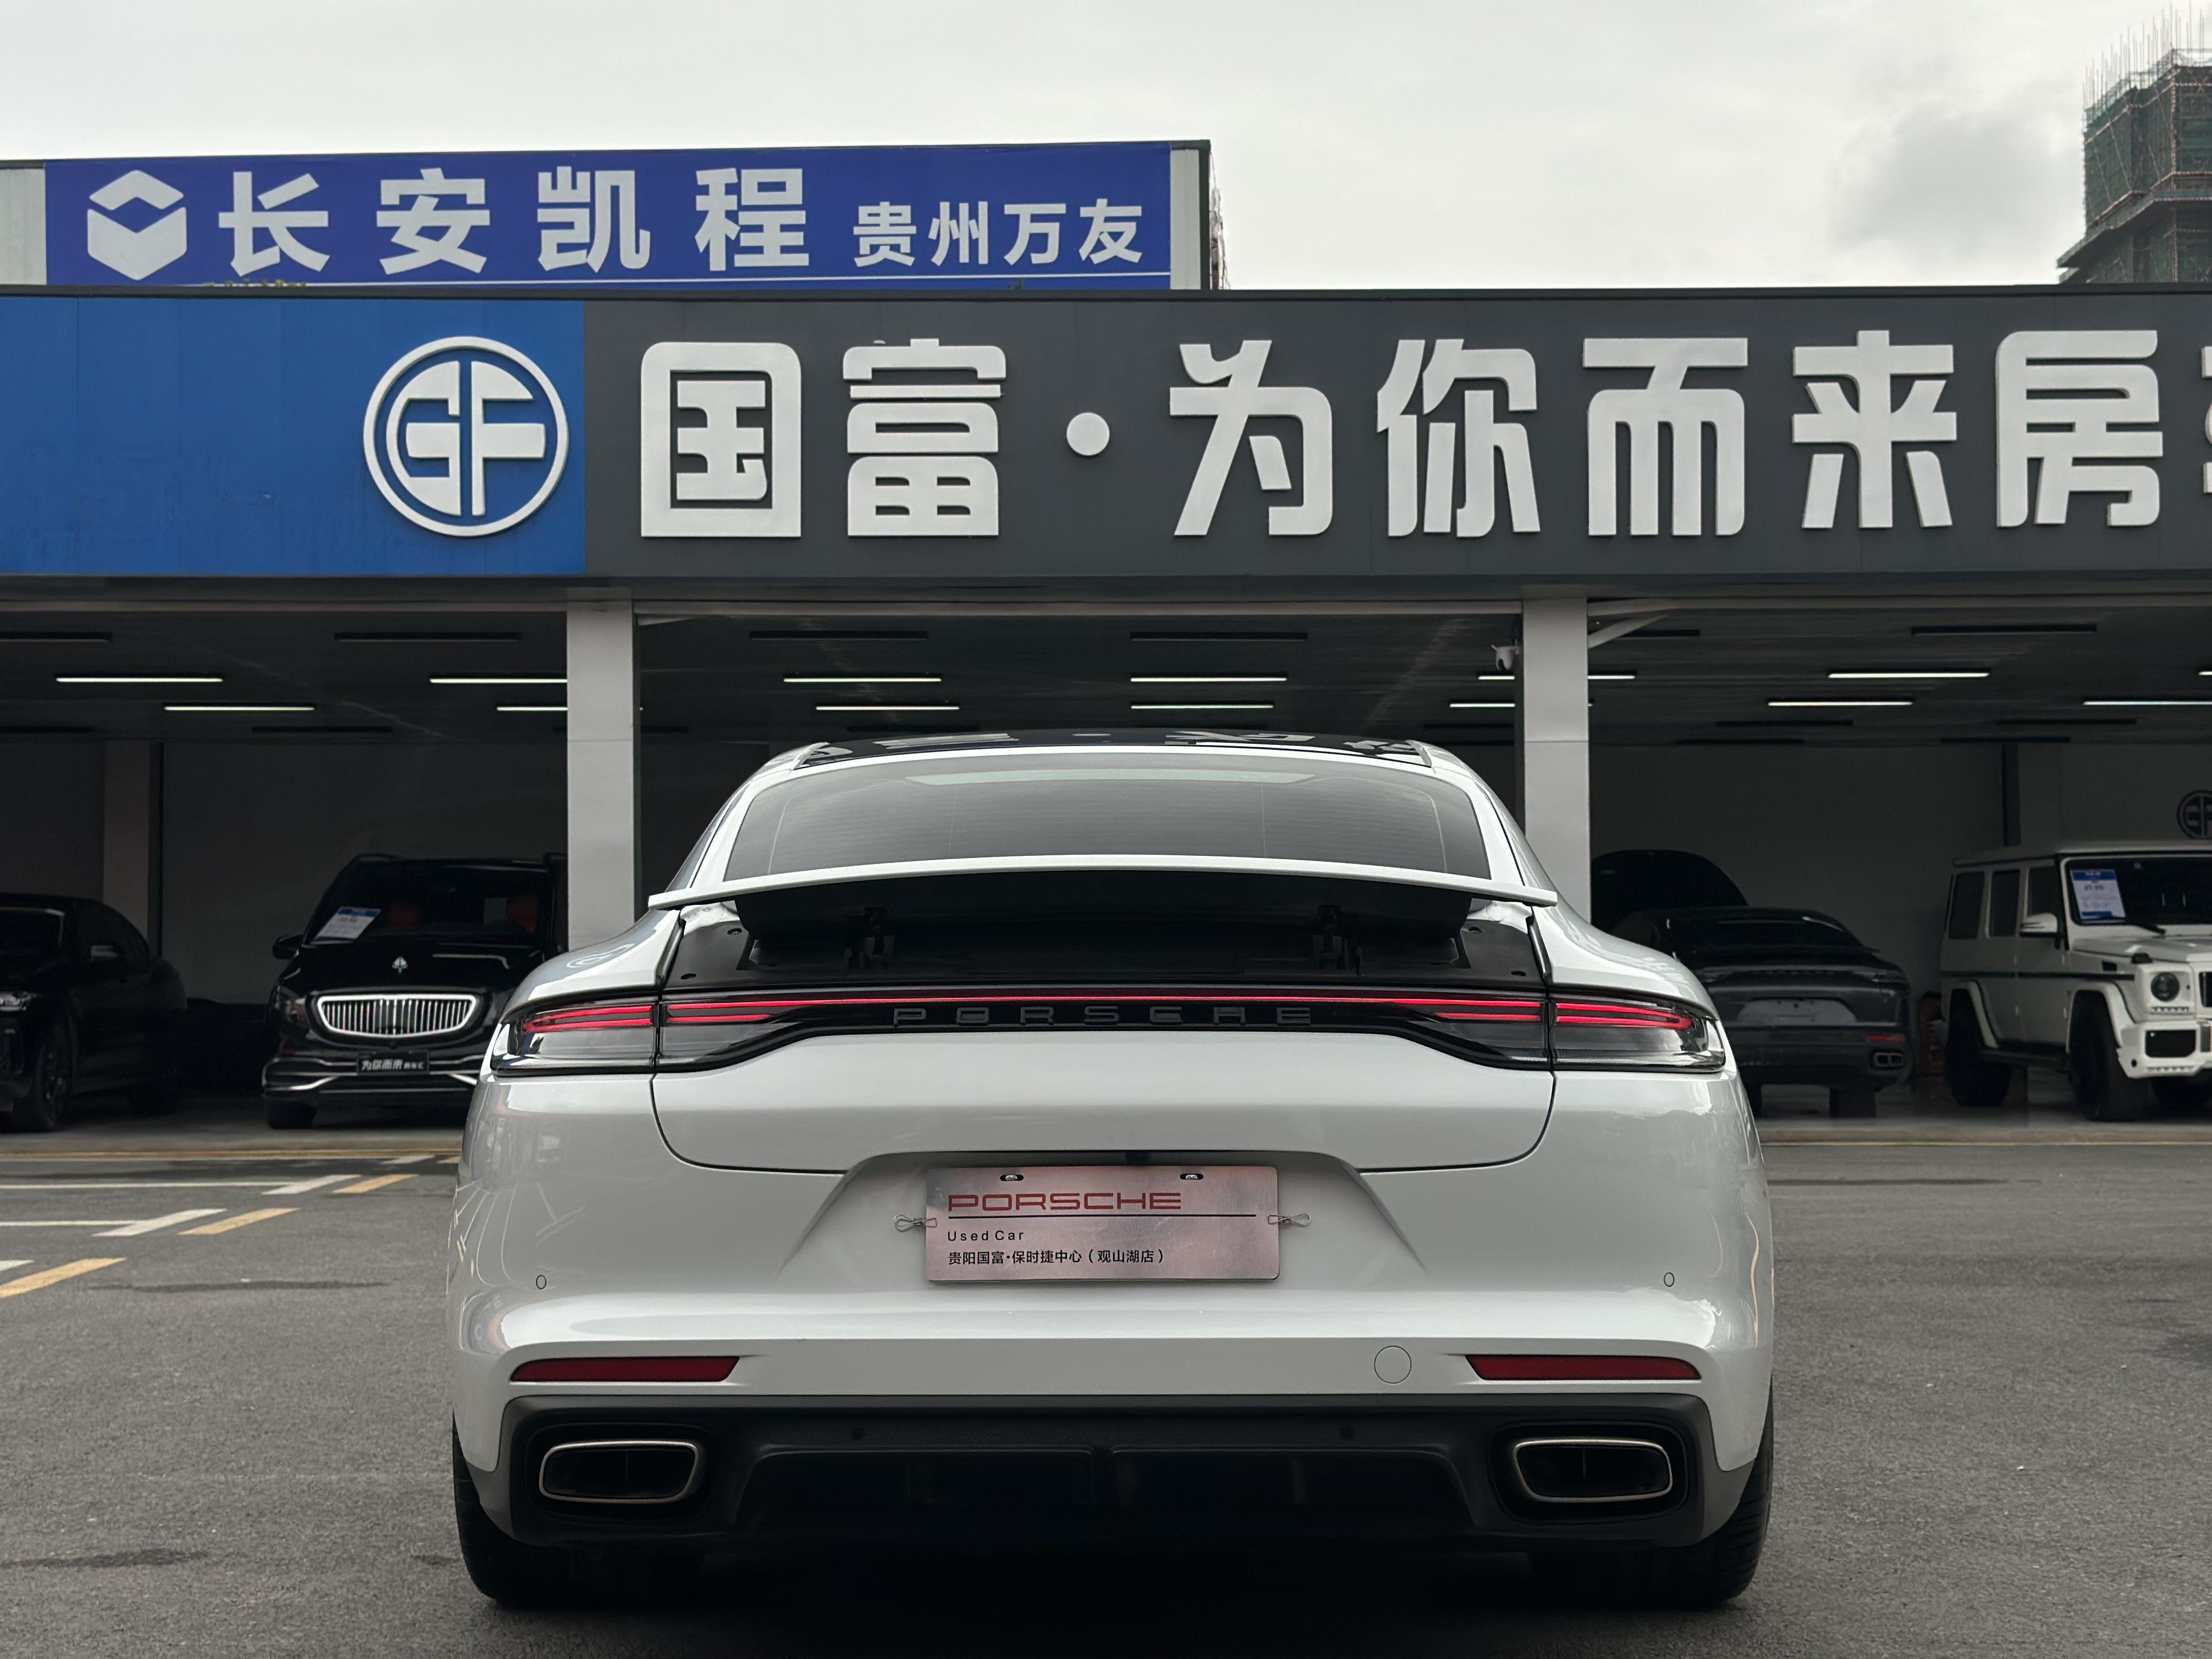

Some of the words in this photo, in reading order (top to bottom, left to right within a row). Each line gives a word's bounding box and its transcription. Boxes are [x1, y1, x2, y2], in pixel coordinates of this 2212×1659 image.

[218, 166, 810, 276] 长安凯程
[853, 199, 1144, 268] 贵州万友
[640, 329, 2212, 538] 国富·为你而来房
[893, 1005, 1312, 1027] PORSCHE
[947, 1192, 1182, 1212] PORSCHE
[947, 1231, 989, 1242] Used
[995, 1230, 1025, 1241] Car
